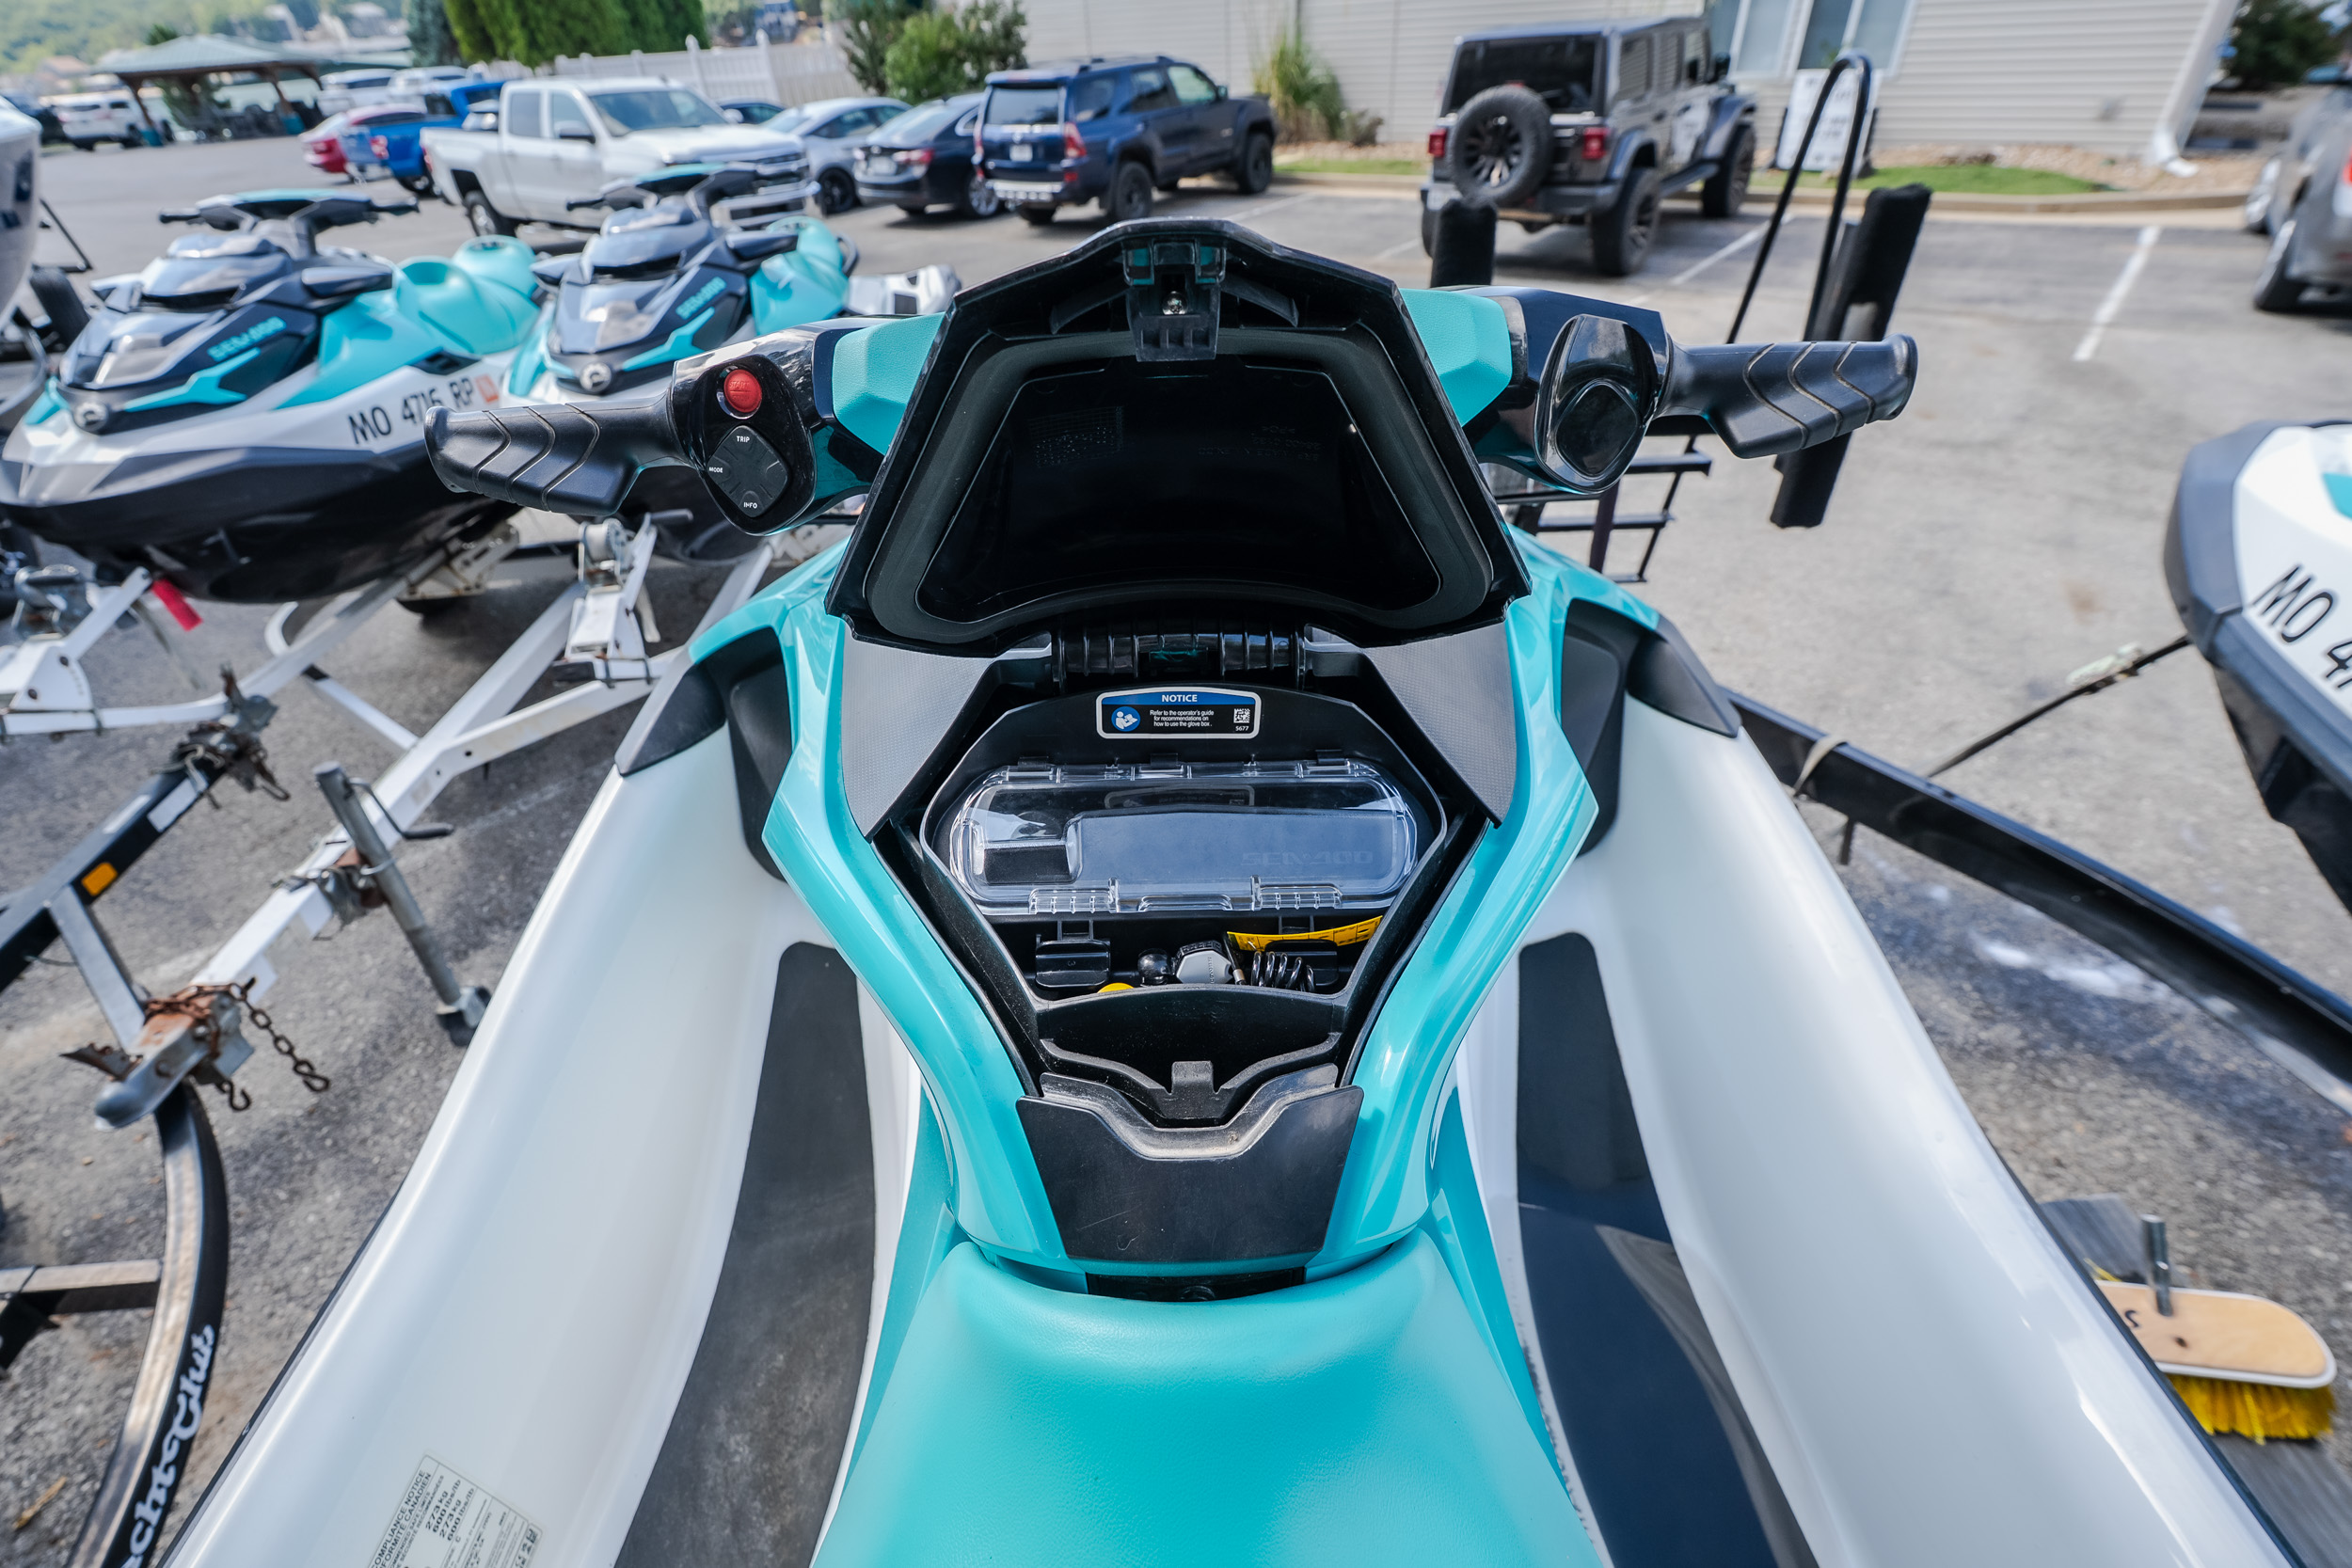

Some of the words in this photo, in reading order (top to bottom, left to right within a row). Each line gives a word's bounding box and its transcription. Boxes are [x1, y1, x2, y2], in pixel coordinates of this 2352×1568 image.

[348, 405, 392, 444] MO
[449, 378, 472, 407] RP
[2252, 565, 2333, 643] MO
[1161, 694, 1198, 703] NOTICE
[404, 1472, 431, 1522] CANADIEN
[405, 1470, 425, 1505] NOTICE
[425, 1505, 440, 1530] 273
[437, 1491, 449, 1504] kg
[432, 1509, 447, 1532] 600
[444, 1480, 461, 1508] lbs/lb
[439, 1513, 454, 1538] 273
[452, 1499, 462, 1513] kg
[447, 1517, 461, 1541] 600
[458, 1488, 474, 1516] lbs/lb
